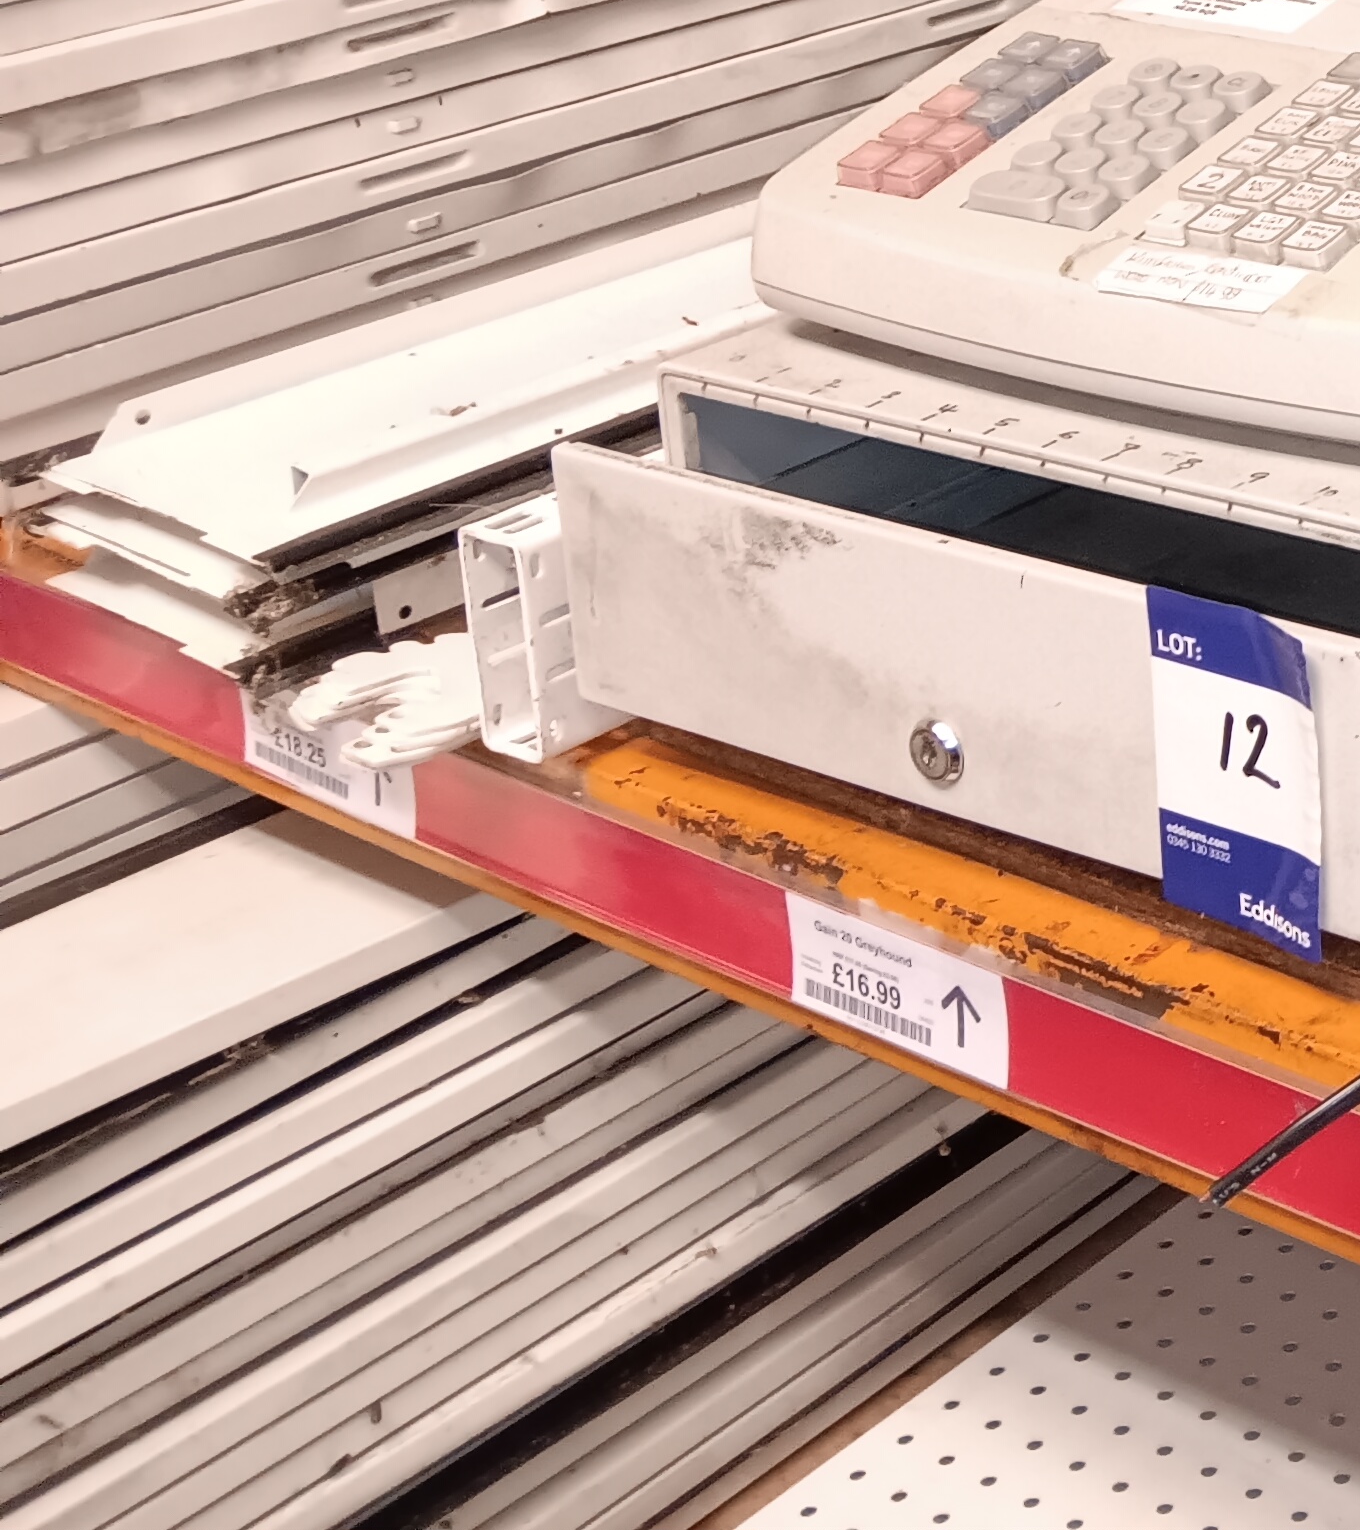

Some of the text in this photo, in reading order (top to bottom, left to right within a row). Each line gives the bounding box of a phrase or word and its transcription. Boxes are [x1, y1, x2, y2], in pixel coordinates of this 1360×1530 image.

[1197, 173, 1224, 189] 2
[1156, 629, 1202, 661] LOT:
[1219, 711, 1281, 789] 12
[1166, 822, 1231, 851] eddisons.com
[813, 920, 837, 939] Gain
[839, 929, 853, 944] 20
[855, 936, 912, 968] Greyhound
[1239, 892, 1311, 949] Eddisons
[832, 962, 901, 1011] £16.99
